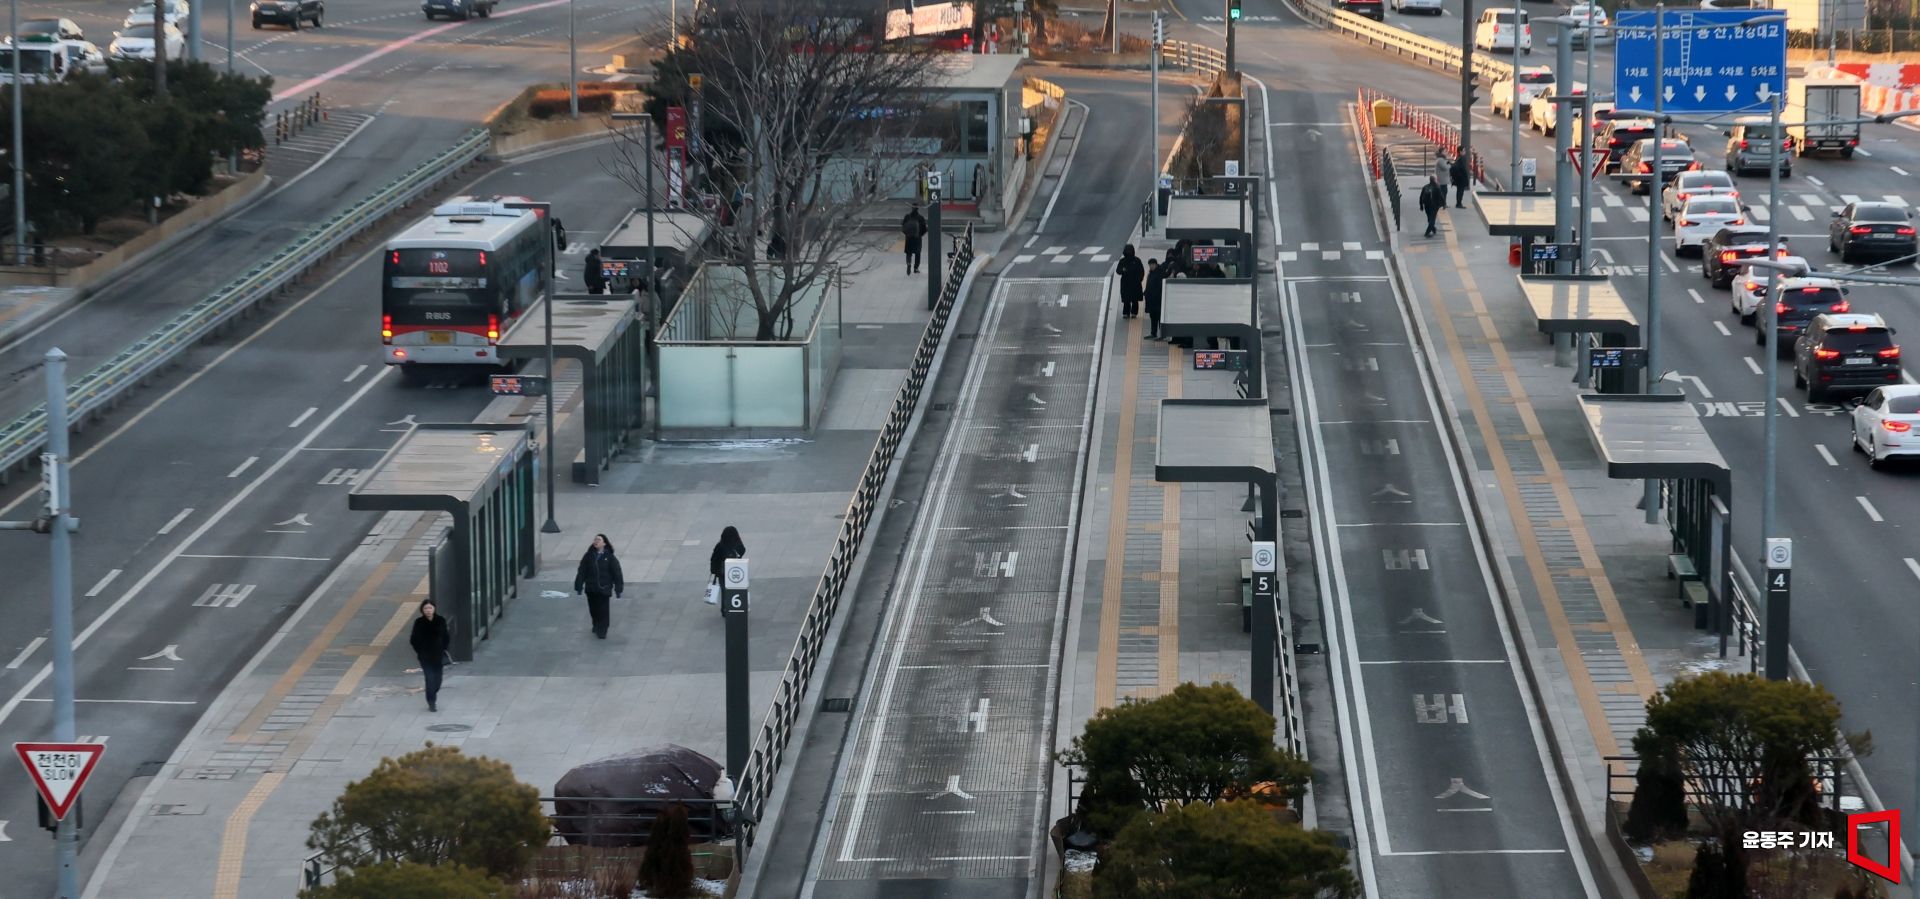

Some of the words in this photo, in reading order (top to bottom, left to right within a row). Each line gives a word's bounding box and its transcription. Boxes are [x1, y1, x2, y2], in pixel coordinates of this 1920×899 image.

[1624, 67, 1649, 77] 1차로
[1688, 66, 1713, 77] 3차로
[1718, 66, 1744, 77] 4차로
[1751, 66, 1778, 77] 5차로
[1526, 178, 1532, 187] 4
[931, 192, 938, 200] 6
[429, 261, 449, 273] 1102
[1258, 576, 1268, 591] 5
[1773, 573, 1785, 587] 4
[731, 594, 742, 608] 6
[37, 753, 81, 768] 천천히
[44, 768, 75, 780] SLOW
